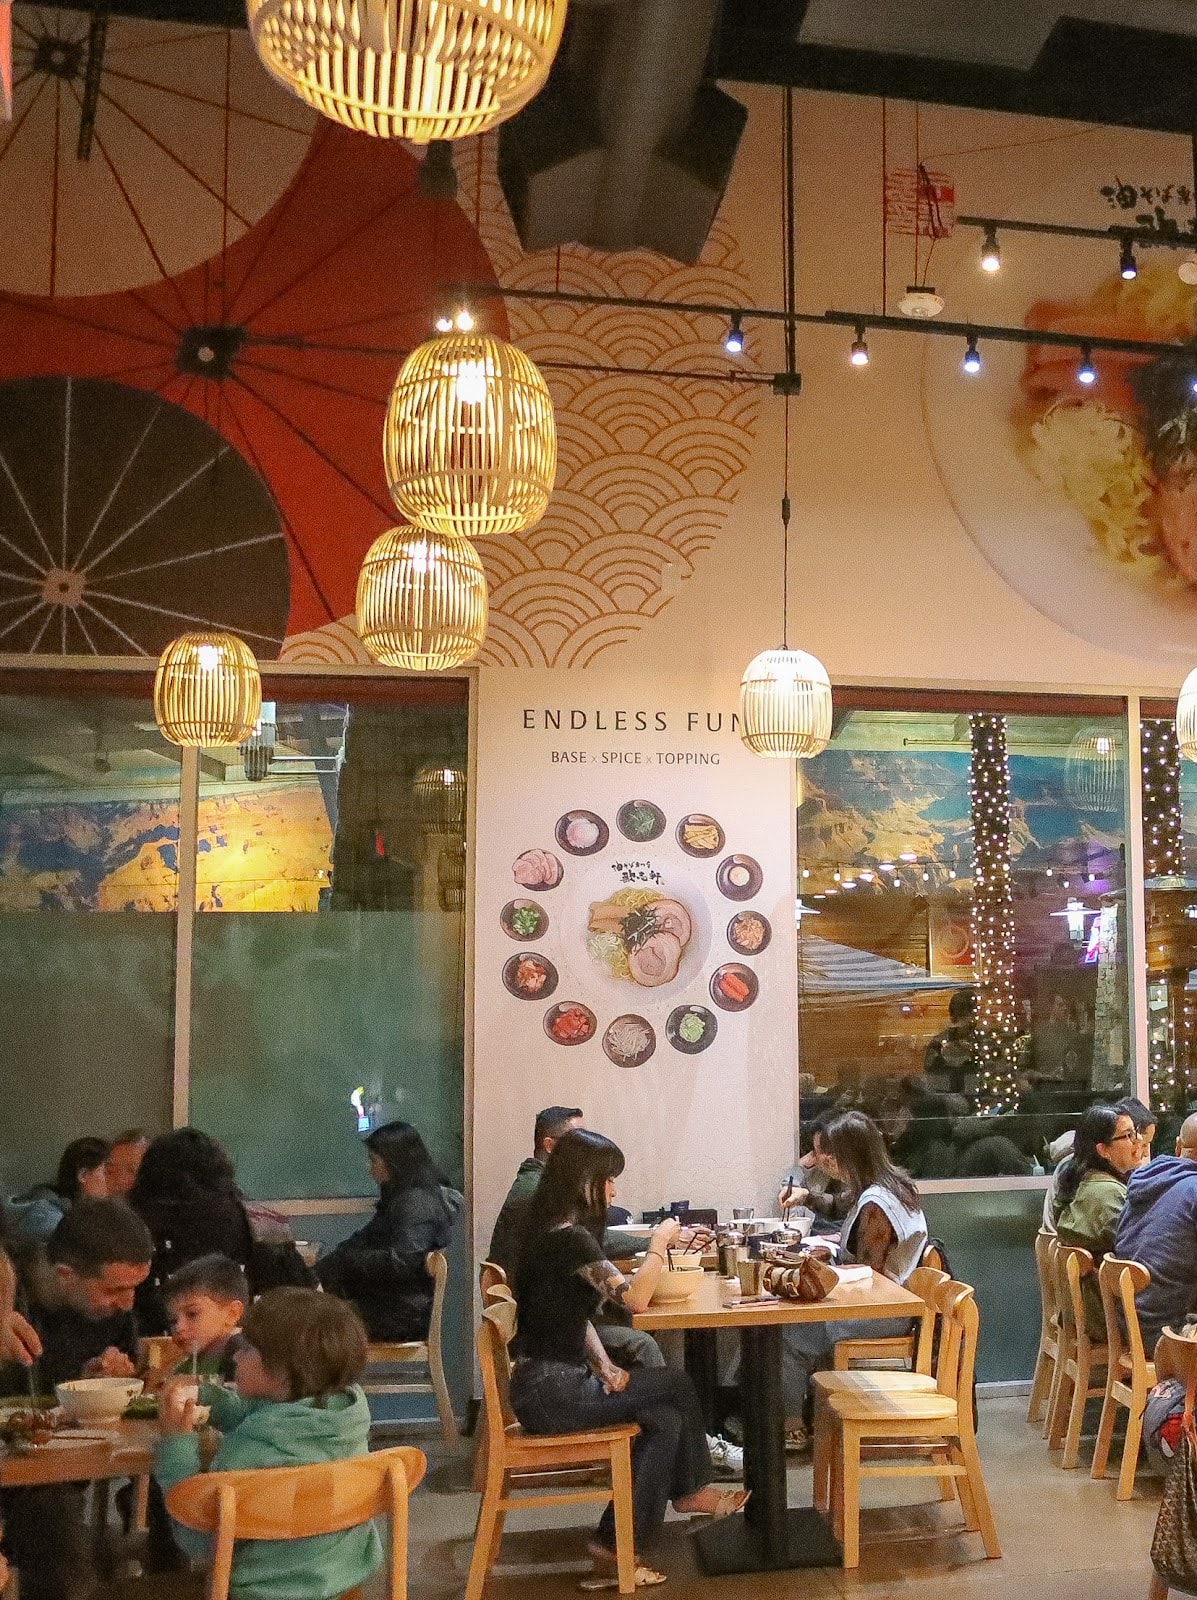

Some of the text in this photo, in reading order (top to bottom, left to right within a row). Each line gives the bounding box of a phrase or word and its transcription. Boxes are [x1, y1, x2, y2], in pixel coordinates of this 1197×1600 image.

[523, 709, 668, 732] ENDLESS
[551, 751, 587, 764] BASE
[601, 752, 642, 764] SPICE
[656, 752, 720, 765] TOPPING
